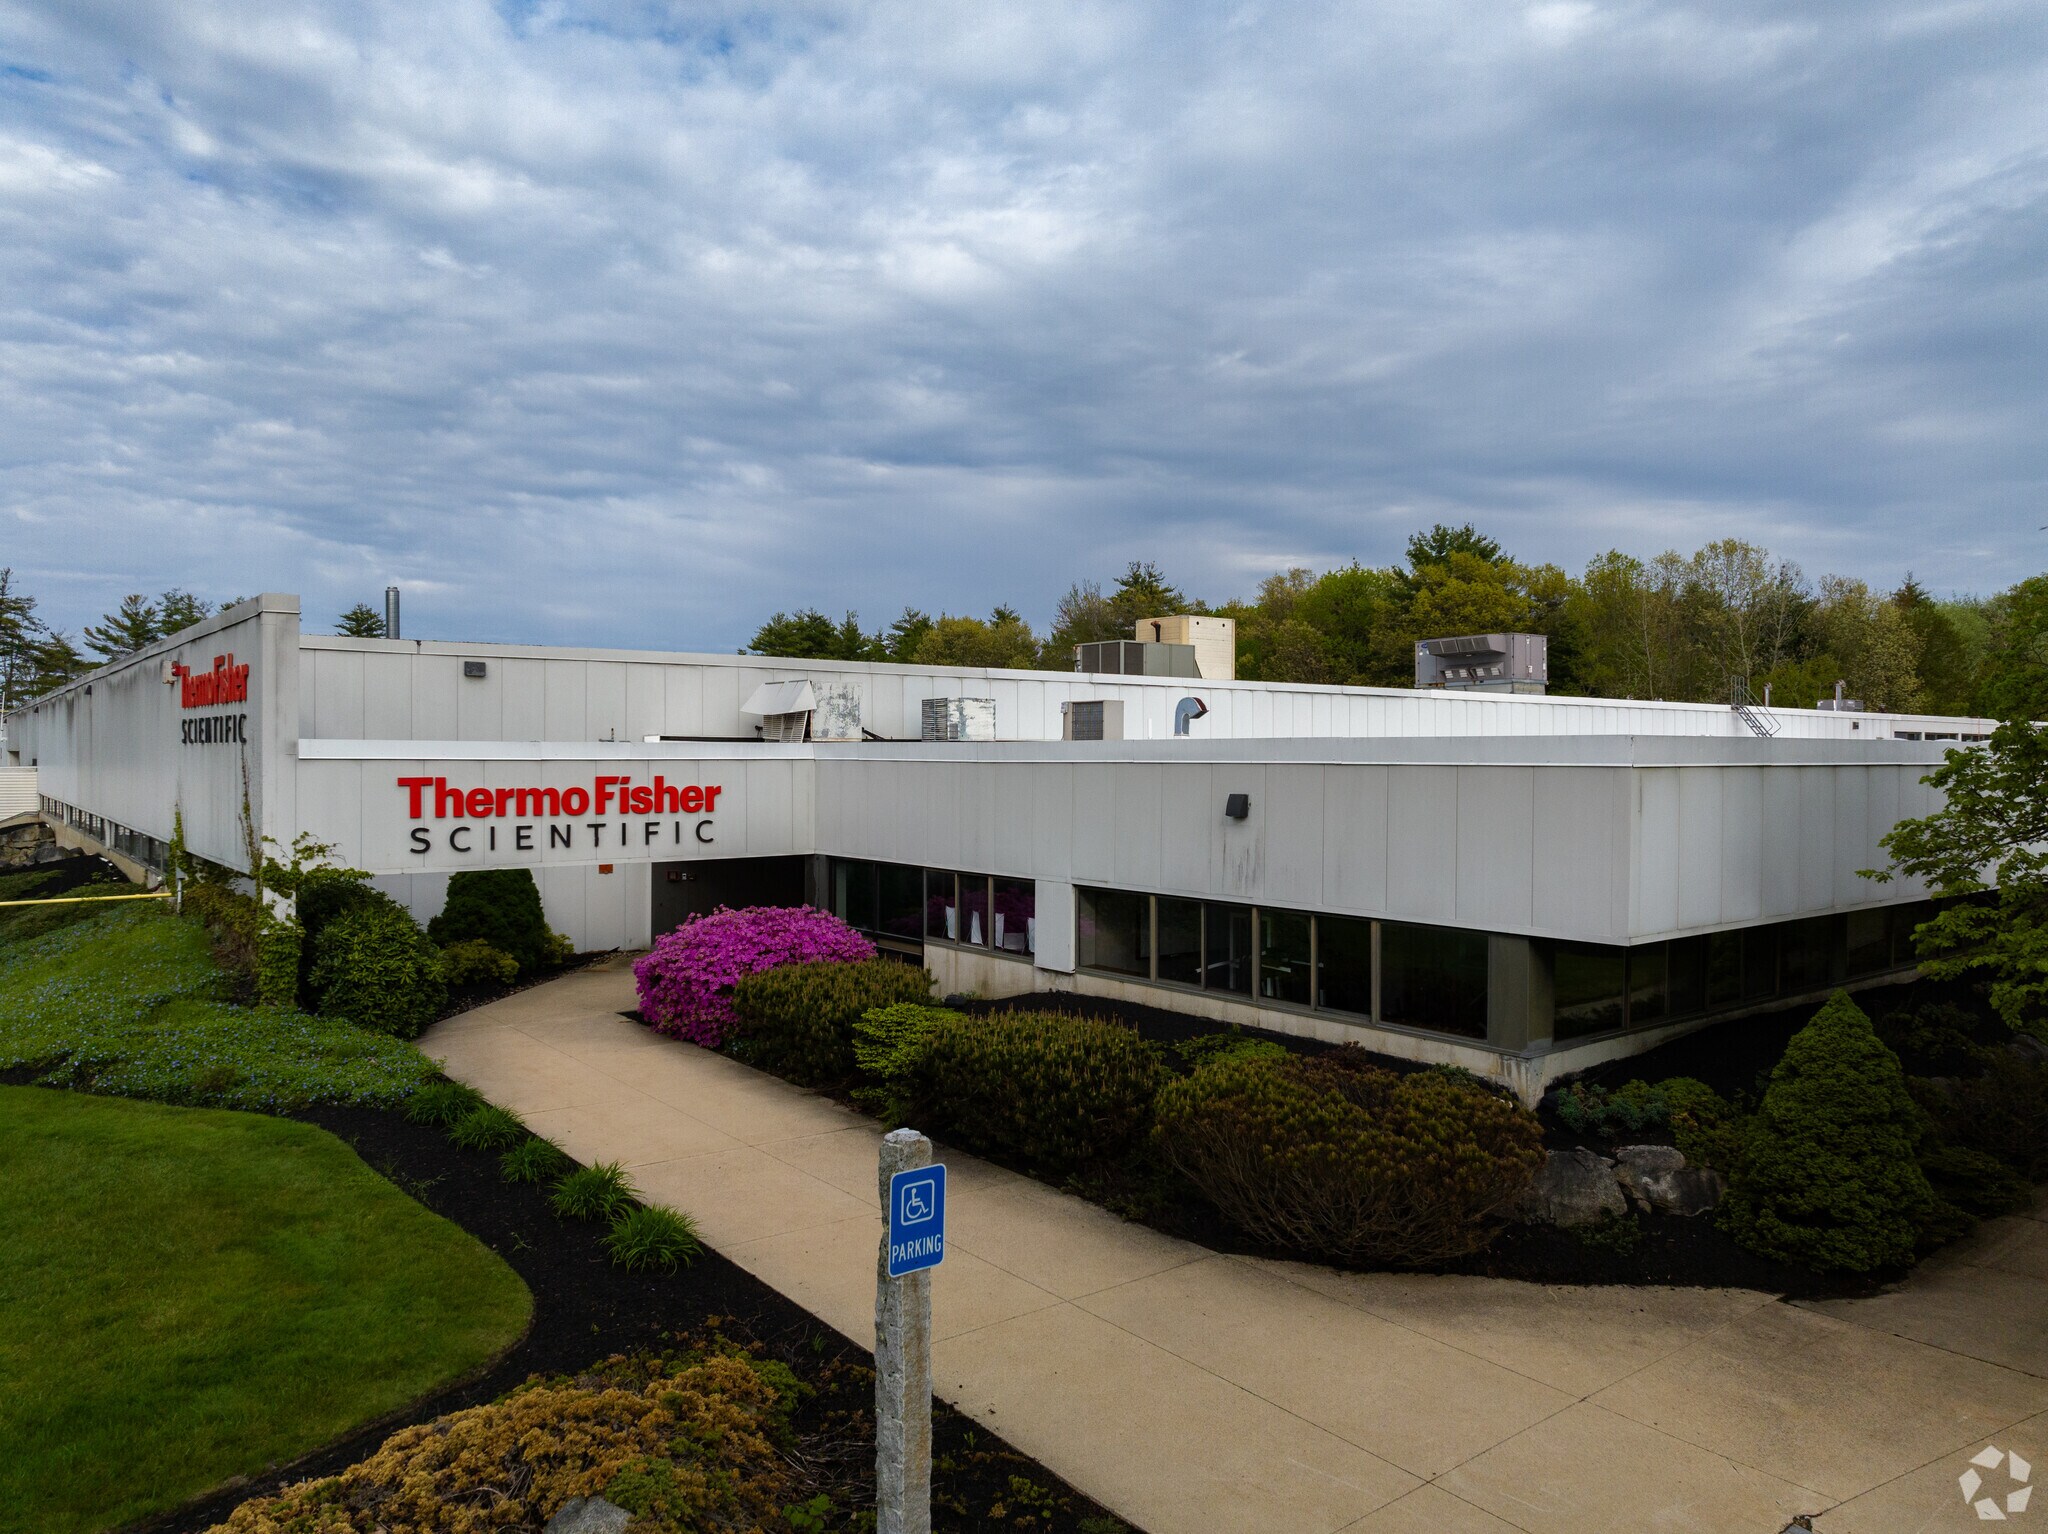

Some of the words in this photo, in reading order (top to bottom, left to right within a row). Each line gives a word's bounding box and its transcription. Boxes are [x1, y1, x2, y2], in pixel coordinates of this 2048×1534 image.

[181, 713, 247, 745] SCIENTIFIC
[409, 819, 715, 853] SCIENTIFIC
[891, 1233, 942, 1264] PARKING
